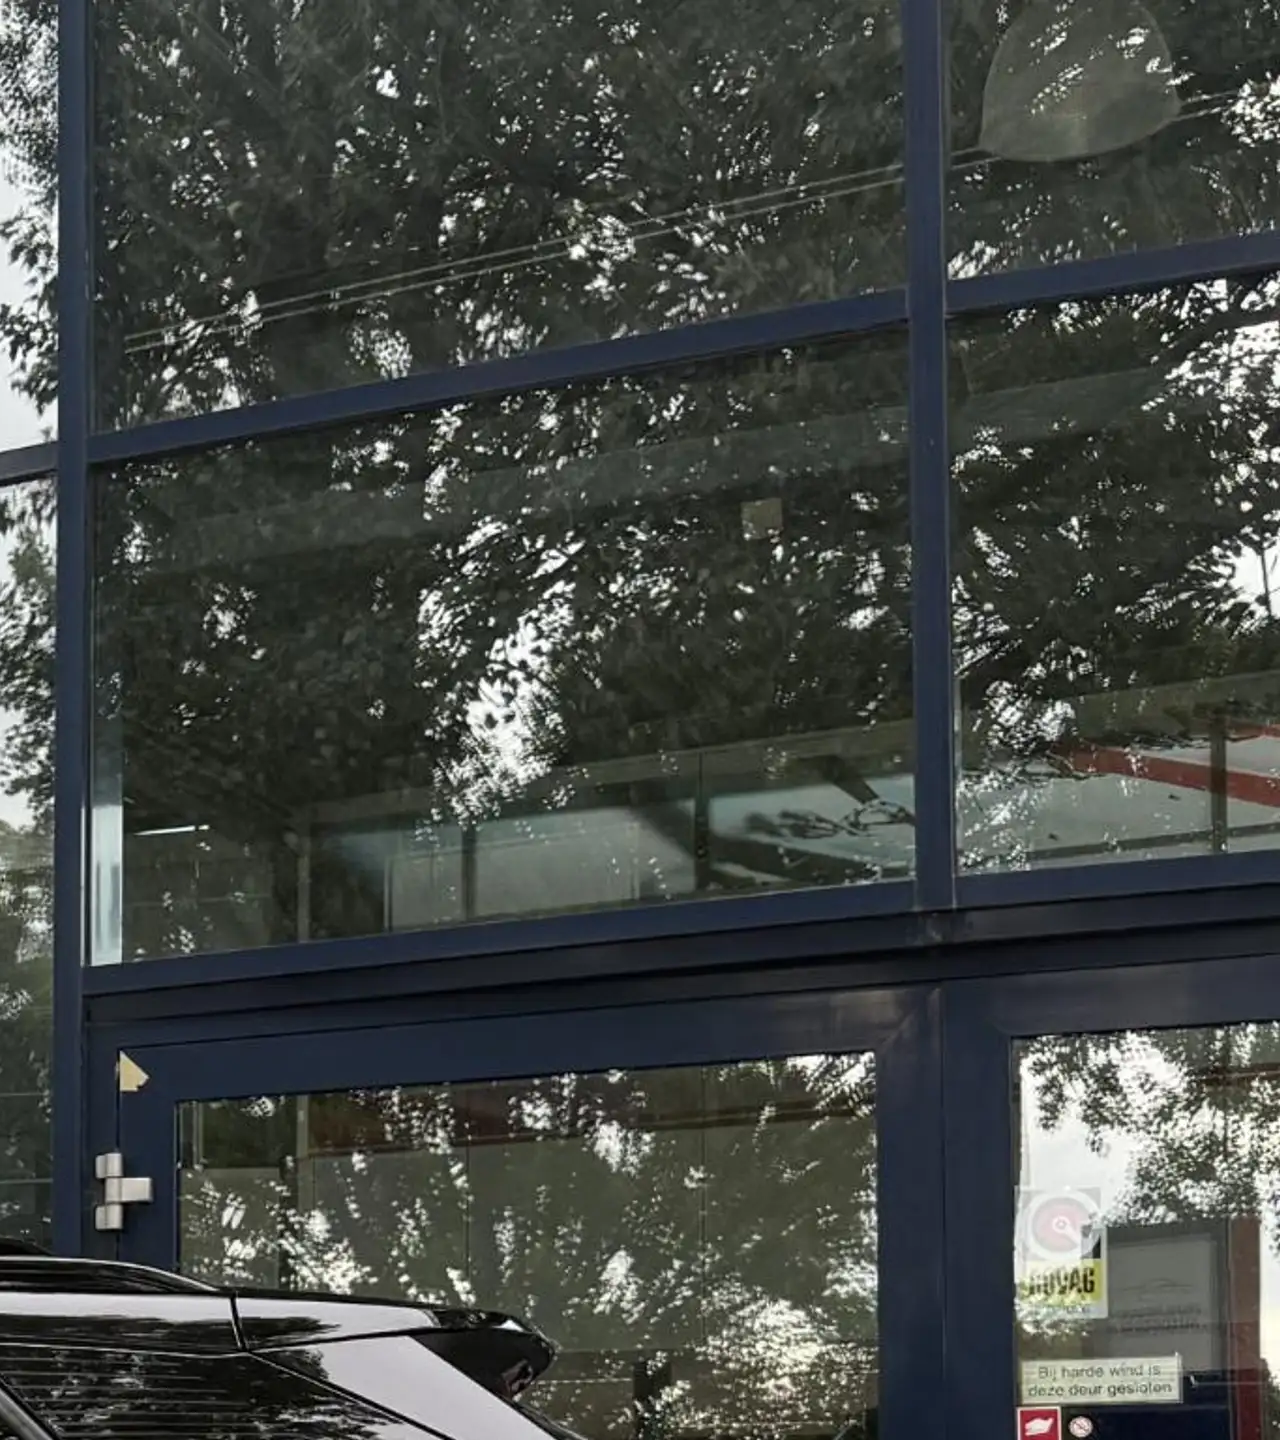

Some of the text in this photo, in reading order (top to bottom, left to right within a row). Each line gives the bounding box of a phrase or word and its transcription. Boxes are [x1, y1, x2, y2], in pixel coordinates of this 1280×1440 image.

[1060, 1364, 1104, 1379] harde
[1109, 1361, 1144, 1377] wind
[1028, 1384, 1065, 1397] deze
[1068, 1383, 1104, 1397] deur
